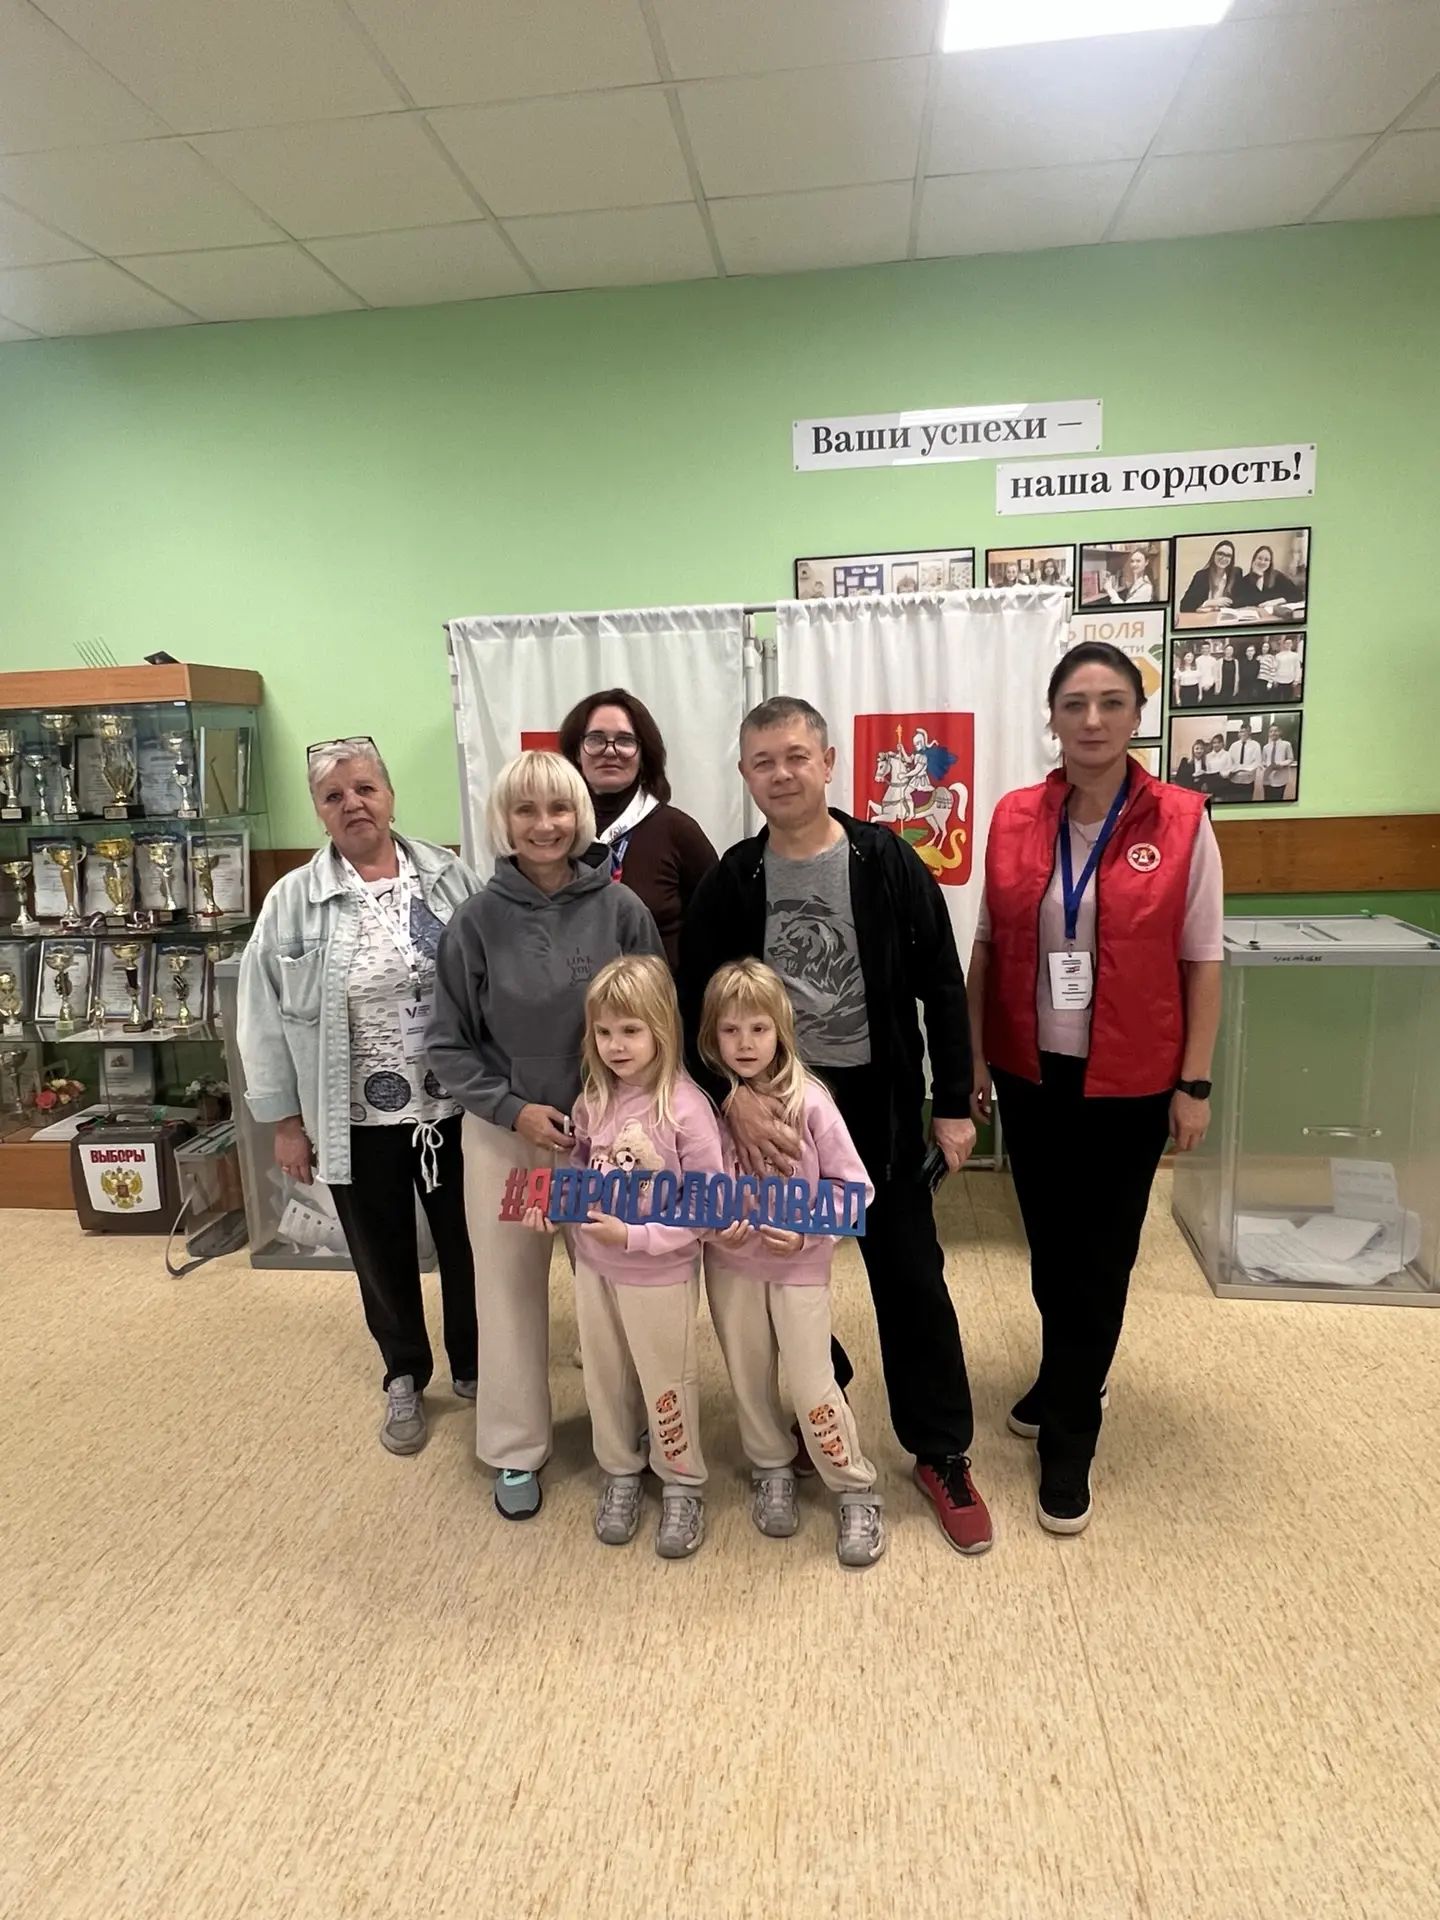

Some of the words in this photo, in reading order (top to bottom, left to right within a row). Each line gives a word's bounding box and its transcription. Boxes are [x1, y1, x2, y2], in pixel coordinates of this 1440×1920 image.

[811, 424, 911, 456] Ваши
[920, 416, 1048, 456] успехи
[1009, 469, 1112, 500] наша
[1121, 451, 1304, 499] гордость!
[1084, 621, 1145, 641] ПОЛЯ
[90, 1149, 146, 1163] ВЫБОРЫ
